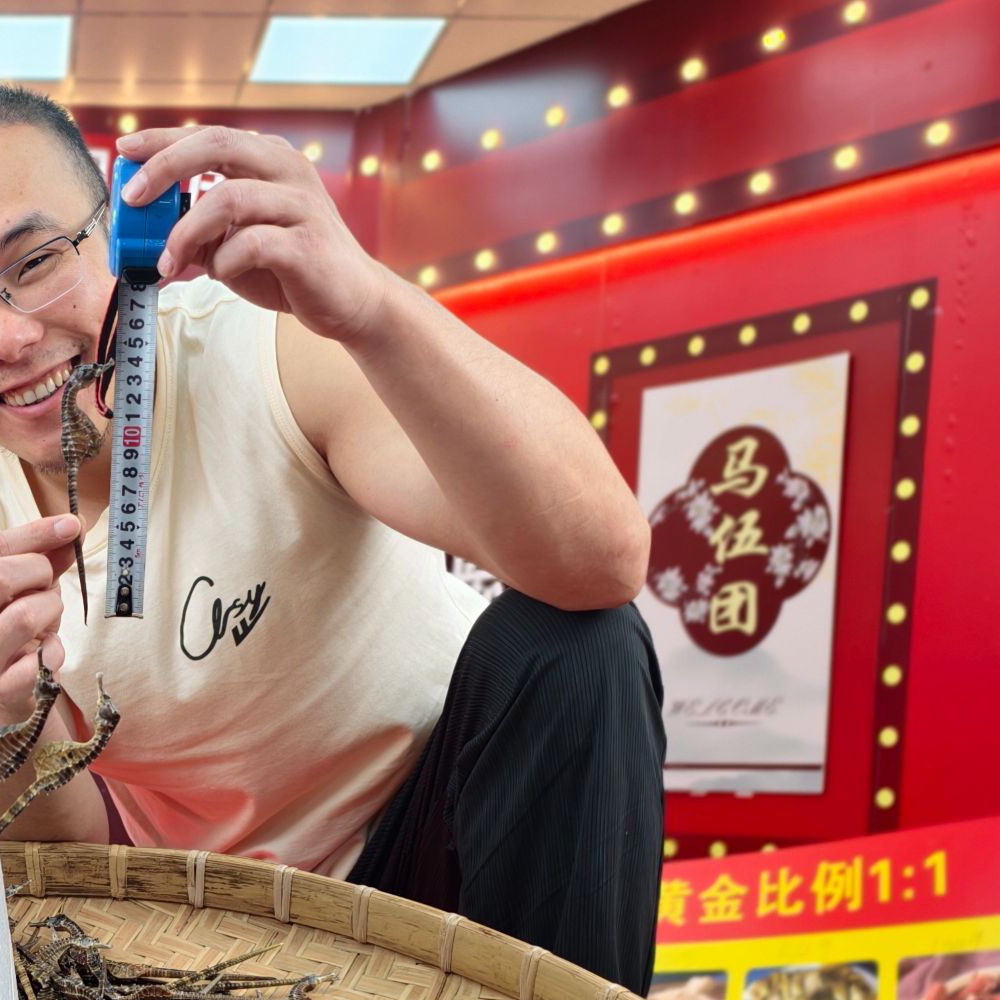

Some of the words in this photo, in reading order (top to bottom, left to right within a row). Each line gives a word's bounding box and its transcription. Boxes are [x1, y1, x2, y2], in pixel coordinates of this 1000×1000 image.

[130, 298, 146, 311] 7
[129, 318, 145, 330] 6
[128, 337, 144, 349] 5
[127, 355, 143, 368] 4
[126, 374, 142, 386] 3
[126, 393, 141, 405] 2
[125, 411, 141, 422] 1
[123, 428, 140, 445] 10
[123, 448, 139, 460] 9
[122, 466, 138, 478] 8
[122, 484, 137, 496] 7
[121, 503, 136, 515] 6
[120, 520, 136, 533] 5
[707, 435, 769, 636] 马伍团
[120, 538, 135, 550] 4
[118, 556, 134, 568] 3
[658, 850, 948, 926] 黄金比例1:1
